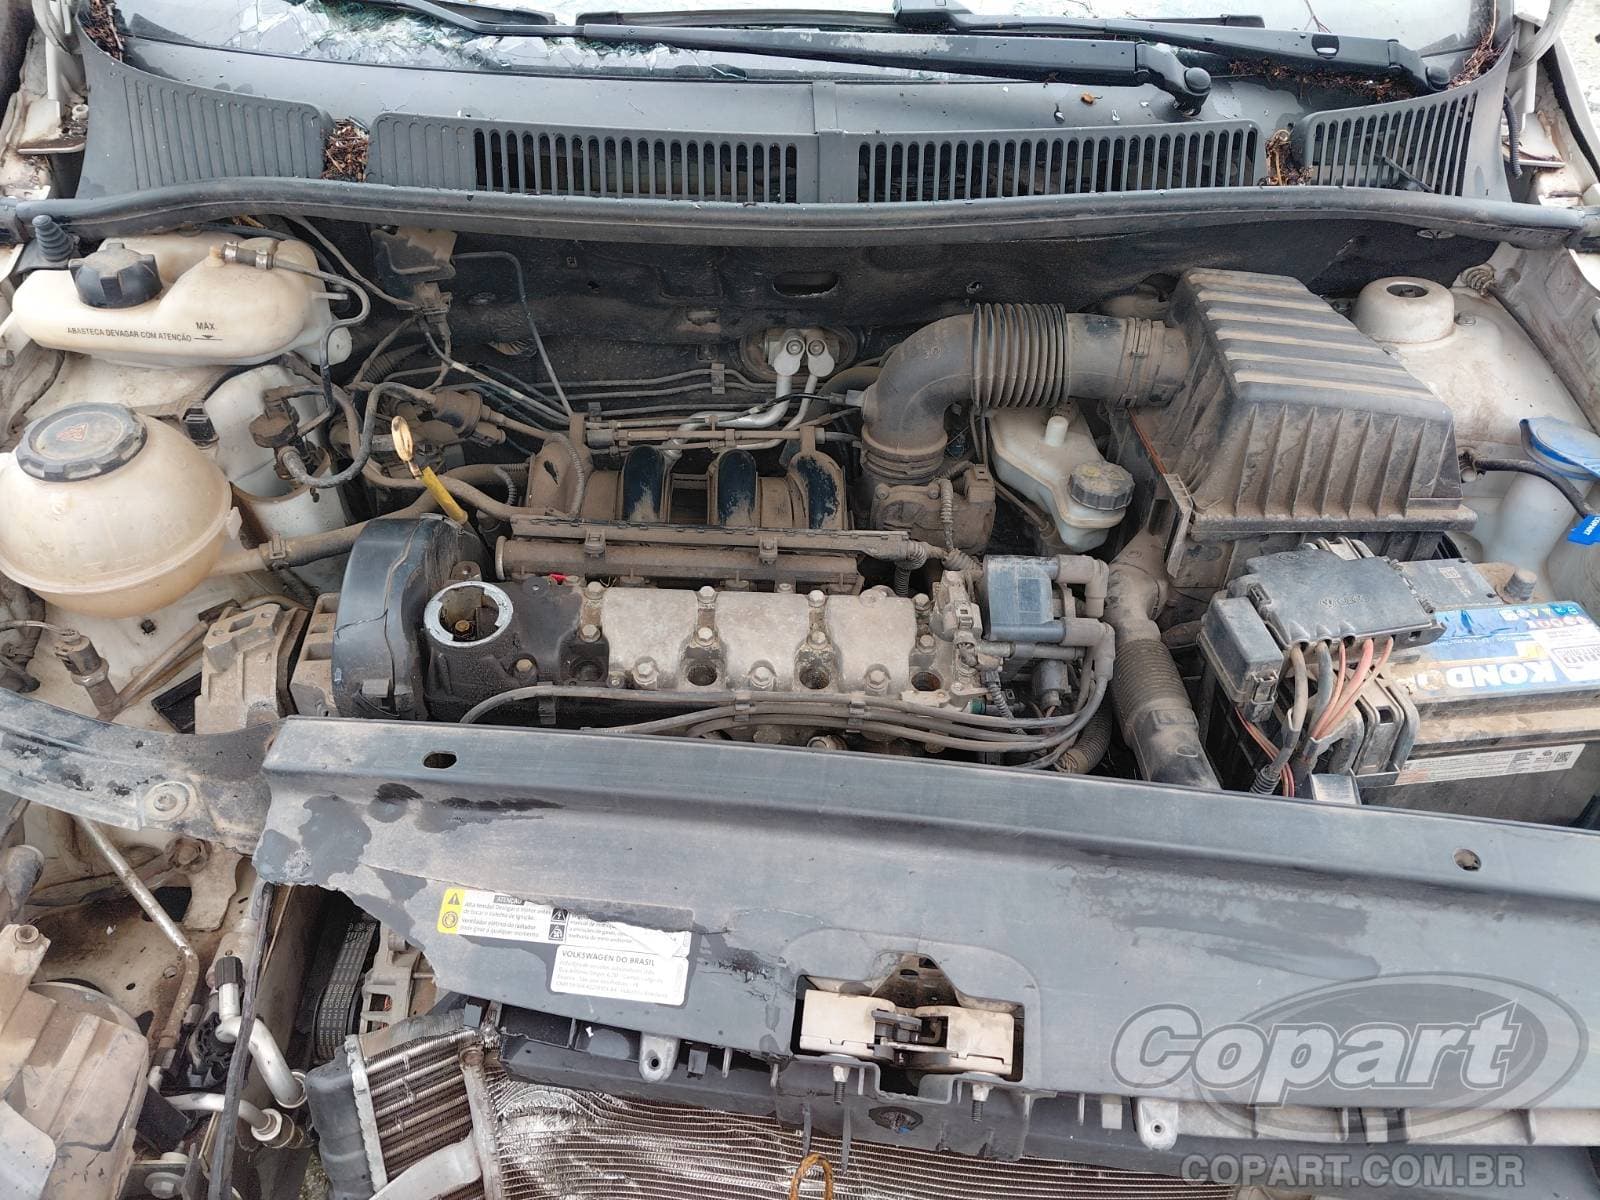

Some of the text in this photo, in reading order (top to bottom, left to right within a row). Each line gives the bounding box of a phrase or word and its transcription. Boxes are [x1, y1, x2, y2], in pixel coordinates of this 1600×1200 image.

[105, 329, 138, 337] DEVAGAR
[561, 950, 614, 962] VOLKSWAGEN
[629, 957, 655, 966] BRASIL
